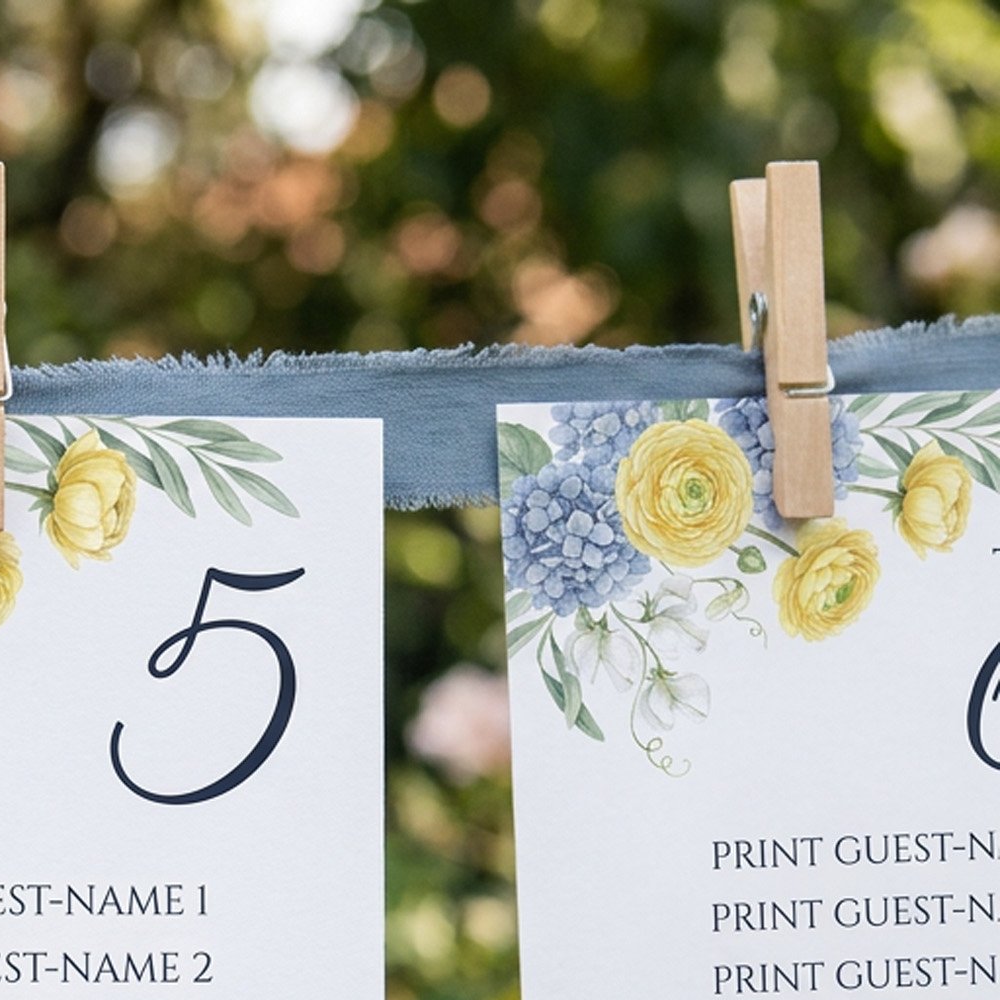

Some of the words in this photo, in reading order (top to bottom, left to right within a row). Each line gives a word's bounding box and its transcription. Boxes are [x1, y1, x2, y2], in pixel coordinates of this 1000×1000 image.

[109, 567, 306, 806] 5
[712, 837, 824, 870] PRINT
[834, 831, 1000, 866] GUEST-N
[198, 884, 206, 915] 1
[712, 899, 823, 933] PRINT
[834, 893, 1000, 928] GUEST-N
[192, 951, 213, 983] 2
[714, 961, 825, 995] PRINT
[835, 955, 996, 990] GUEST-N
